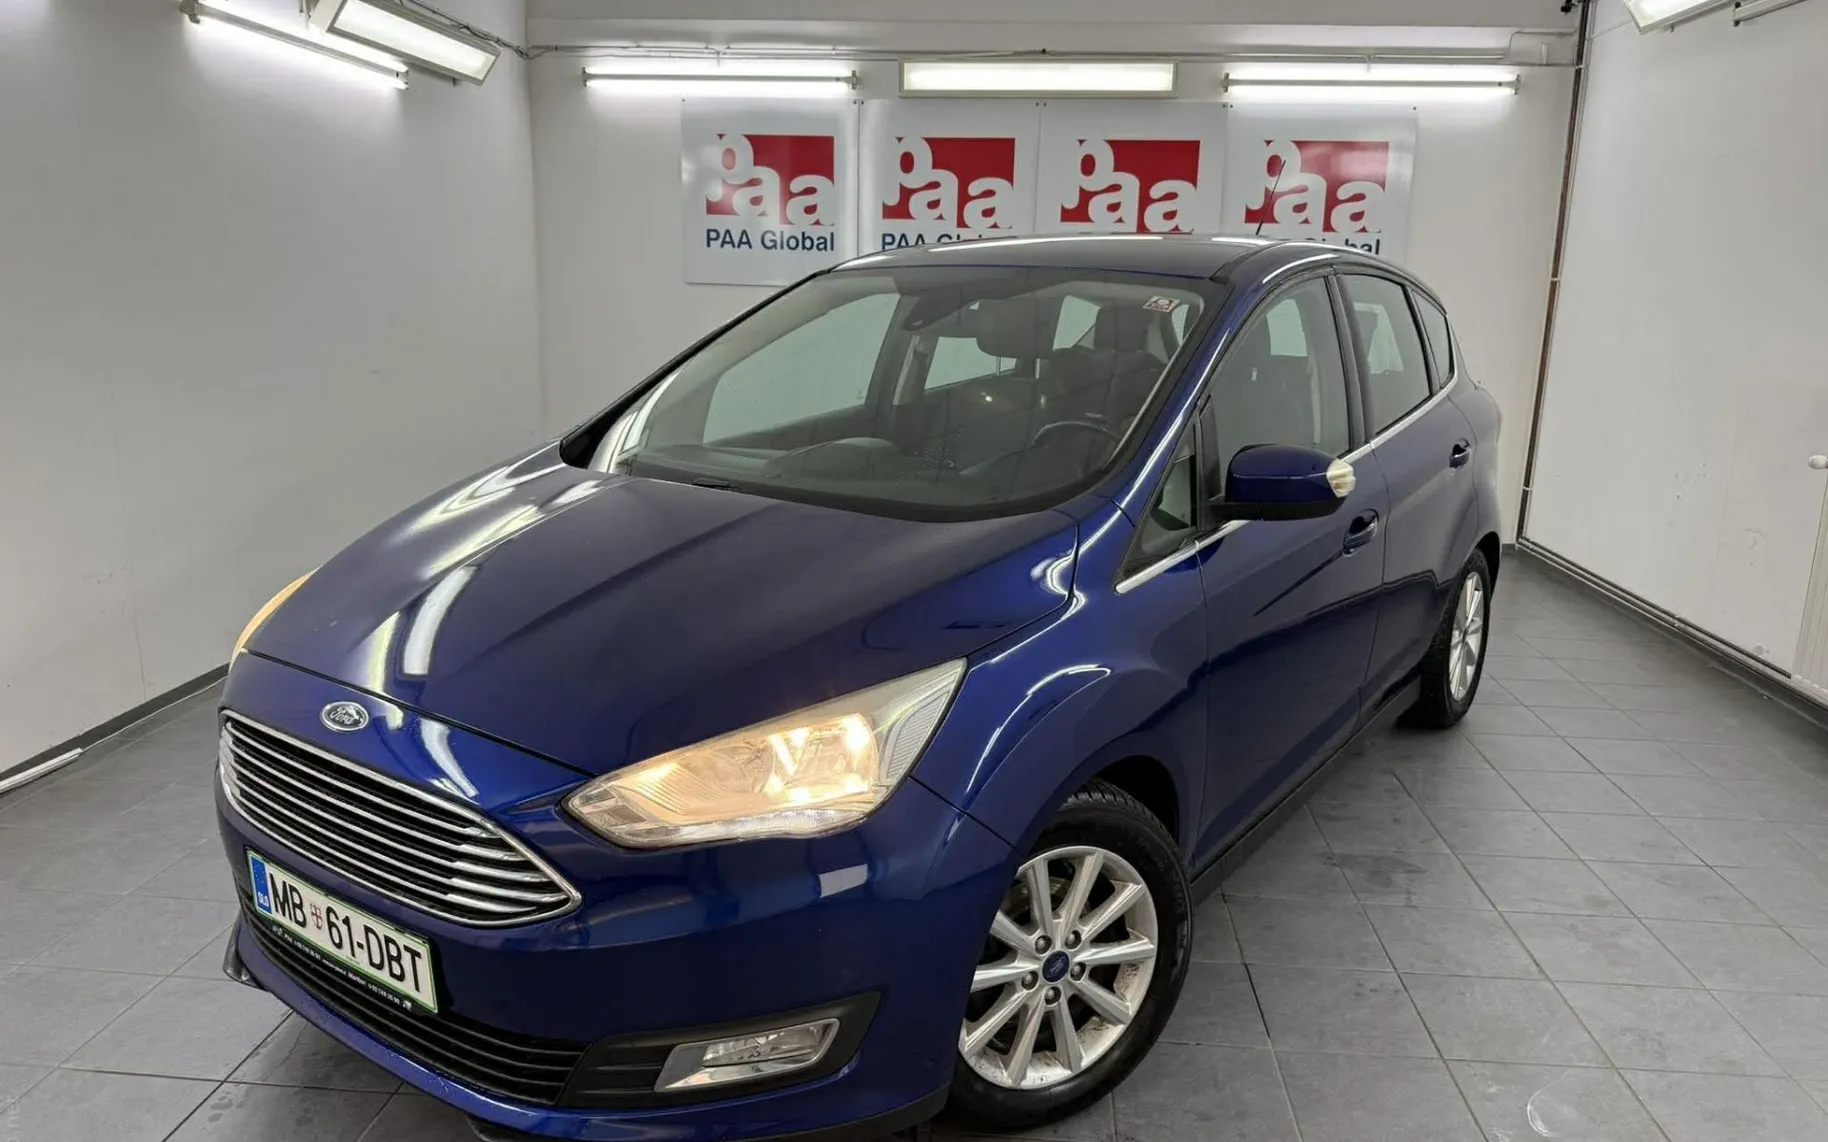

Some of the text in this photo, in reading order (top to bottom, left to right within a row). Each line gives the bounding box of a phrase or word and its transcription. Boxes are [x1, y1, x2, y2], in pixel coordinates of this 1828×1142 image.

[706, 134, 834, 227] paa
[882, 136, 1016, 229] paa
[1060, 139, 1198, 234] paa
[1245, 140, 1386, 234] paa
[706, 229, 835, 252] PAA Global
[269, 873, 422, 993] MB 61-DBT
